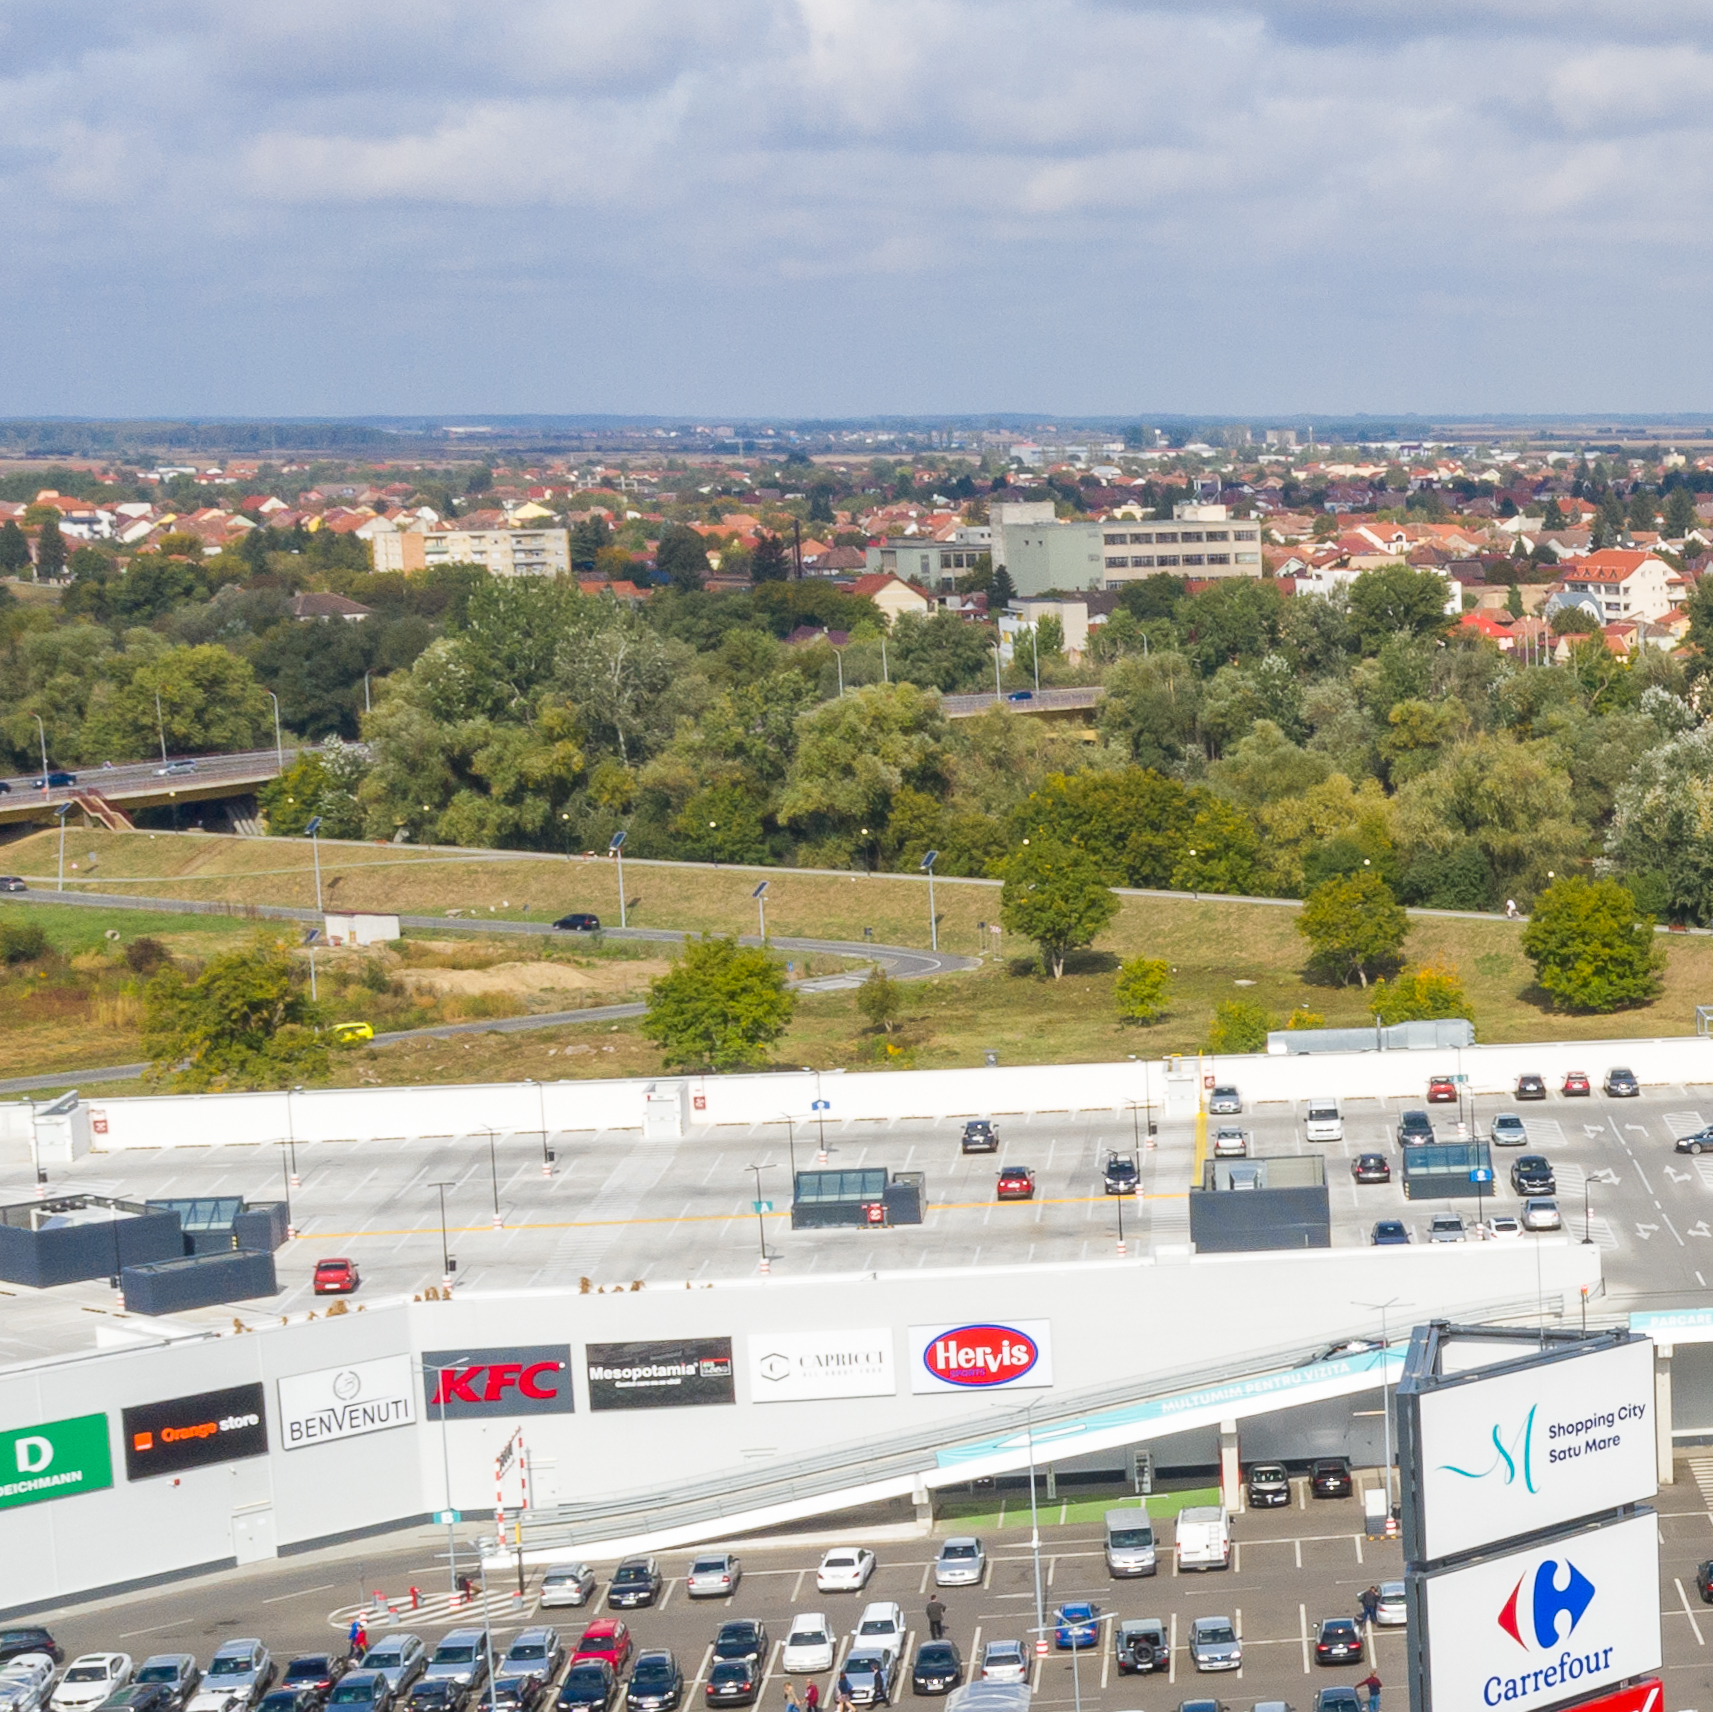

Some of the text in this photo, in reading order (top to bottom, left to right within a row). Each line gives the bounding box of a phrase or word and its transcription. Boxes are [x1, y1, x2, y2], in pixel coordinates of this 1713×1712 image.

[760, 1202, 770, 1214] A
[1650, 1310, 1713, 1328] PARCARE
[589, 1362, 697, 1381] Mesopotamia
[799, 1351, 883, 1369] CAPRICCI
[935, 1340, 1029, 1373] Hervis
[431, 1361, 560, 1404] KFC
[160, 1413, 260, 1443] Orange store
[290, 1396, 409, 1441] BENVENUTI
[1549, 1402, 1647, 1441] Shopping City
[15, 1436, 54, 1473] D
[1549, 1433, 1621, 1465] Satu Mare
[440, 1511, 454, 1524] B
[1483, 1646, 1614, 1707] Carrefour
